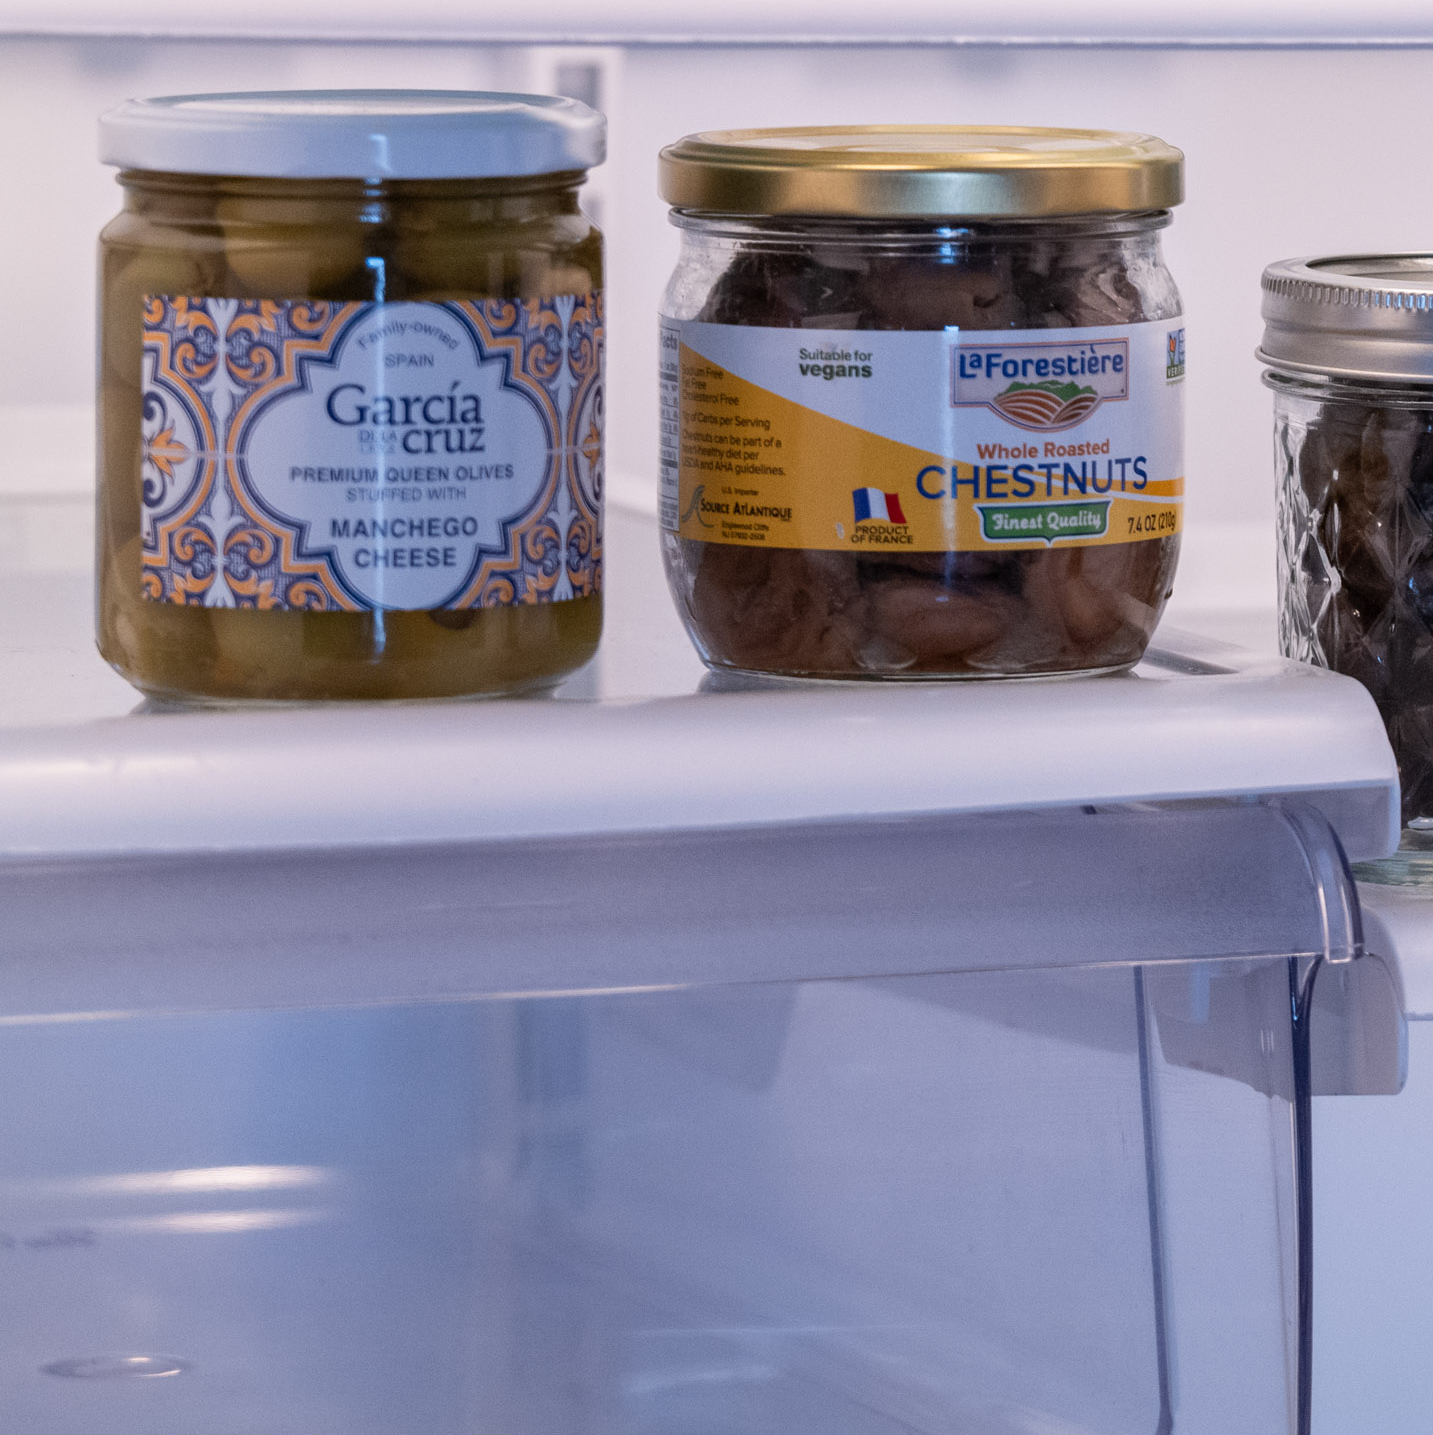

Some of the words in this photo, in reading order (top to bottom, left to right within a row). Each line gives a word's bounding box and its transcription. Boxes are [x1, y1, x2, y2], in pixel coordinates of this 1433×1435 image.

[355, 318, 461, 353] Family-owned
[384, 352, 435, 368] SPAIN
[799, 347, 851, 363] Suitable
[853, 350, 873, 364] for
[799, 362, 873, 381] vegans
[325, 379, 486, 426] García
[735, 415, 771, 431] Serving
[402, 426, 486, 454] cruz
[730, 433, 742, 445] be
[743, 435, 762, 448] part
[764, 435, 774, 447] of
[976, 441, 1040, 459] Whole
[1043, 438, 1111, 459] Roasted
[726, 447, 742, 459] diet
[743, 451, 759, 462] per
[289, 467, 378, 483] PREMIUM
[384, 467, 448, 483] QUEEN
[455, 463, 515, 482] OLIVES
[915, 455, 1148, 501] CHESTNUTS
[345, 487, 423, 504] STUFFED
[426, 486, 467, 502] WITH
[331, 516, 478, 540] MANCHEGO
[854, 525, 909, 536] PRODUCT
[991, 513, 1040, 532] Finest
[1046, 510, 1102, 530] Quality
[1127, 517, 1143, 534] 7.4
[1144, 514, 1157, 532] OZ
[851, 533, 865, 544] OF
[866, 533, 914, 545] FRANCE
[353, 547, 457, 568] CHEESE
